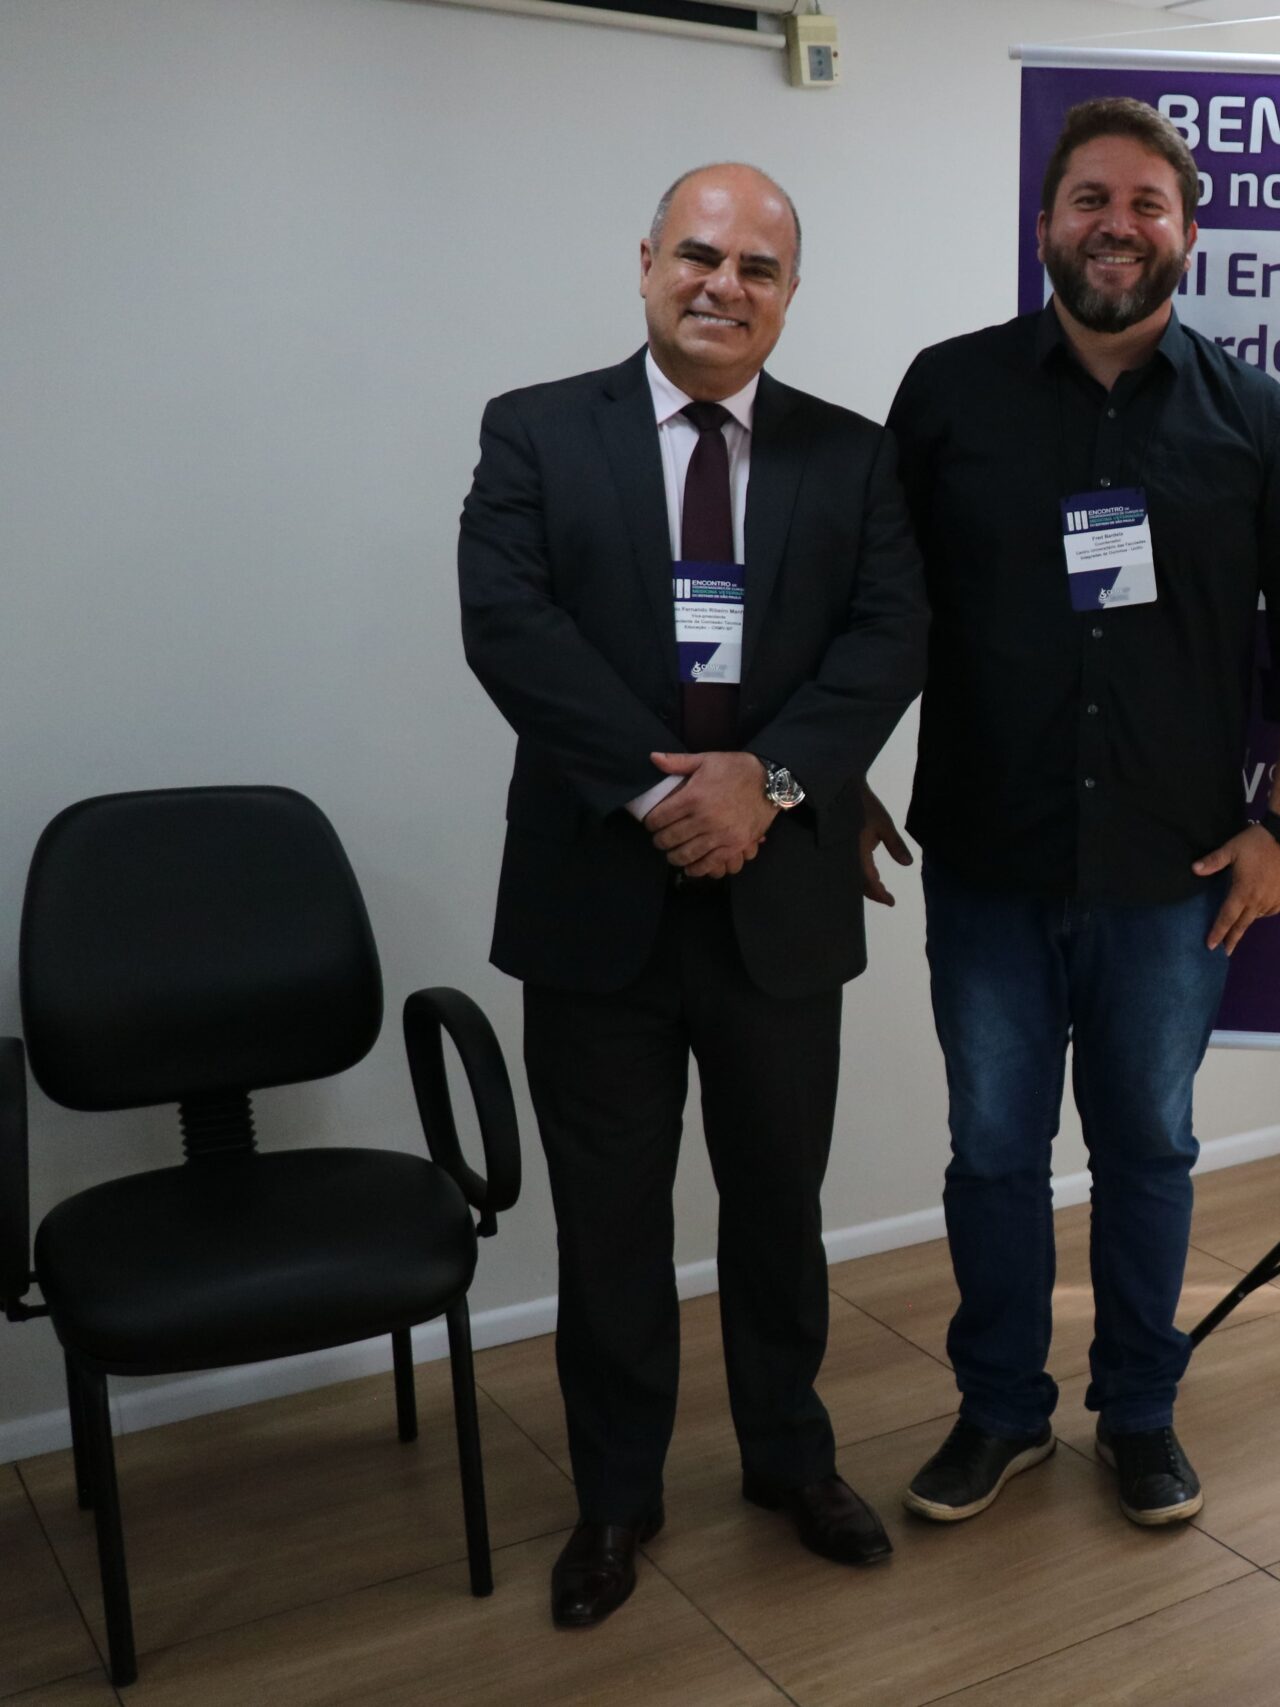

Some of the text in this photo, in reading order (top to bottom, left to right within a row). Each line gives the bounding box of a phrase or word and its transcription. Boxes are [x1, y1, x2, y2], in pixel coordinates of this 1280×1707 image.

[1197, 171, 1214, 207] o
[1066, 510, 1089, 532] III
[1088, 506, 1124, 516] ENCONTRO
[691, 580, 731, 588] ENCONTRO
